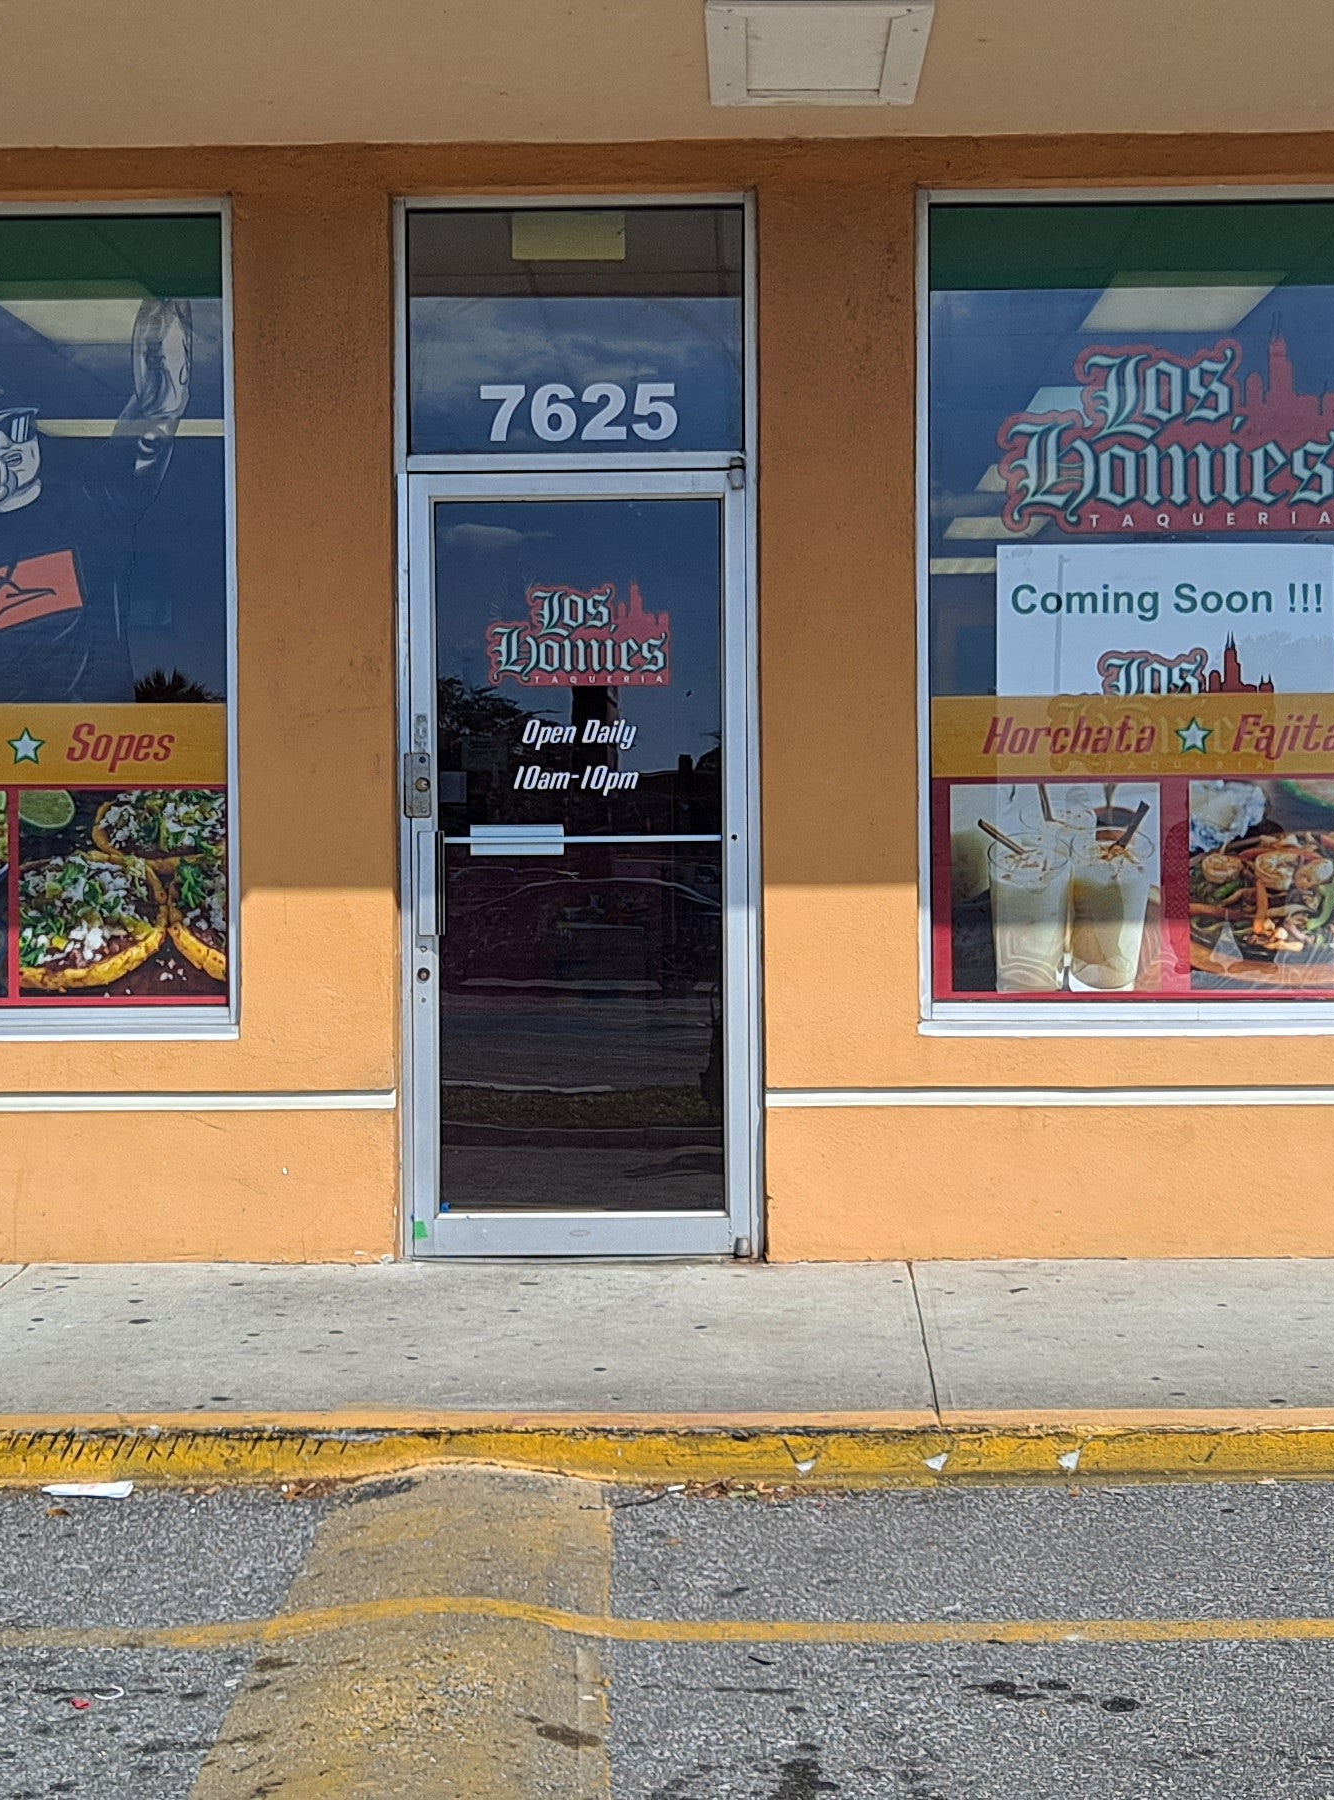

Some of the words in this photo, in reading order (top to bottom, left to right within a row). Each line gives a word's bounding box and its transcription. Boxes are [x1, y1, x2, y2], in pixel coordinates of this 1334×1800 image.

[480, 382, 678, 442] 7625
[1084, 348, 1235, 440] Los
[1088, 511, 1332, 529] TAQUERIA
[530, 588, 612, 637] Los
[1011, 583, 1160, 621] Coming
[1173, 582, 1273, 614] Soon
[1288, 582, 1324, 613] !!!
[490, 626, 667, 682] Homies
[534, 674, 664, 685] TAQUERIA
[66, 722, 175, 773] Sopes
[522, 719, 577, 750] Open
[582, 719, 637, 750] Daily
[982, 715, 1157, 755] Horchata
[513, 765, 639, 796] 10am-10pm
